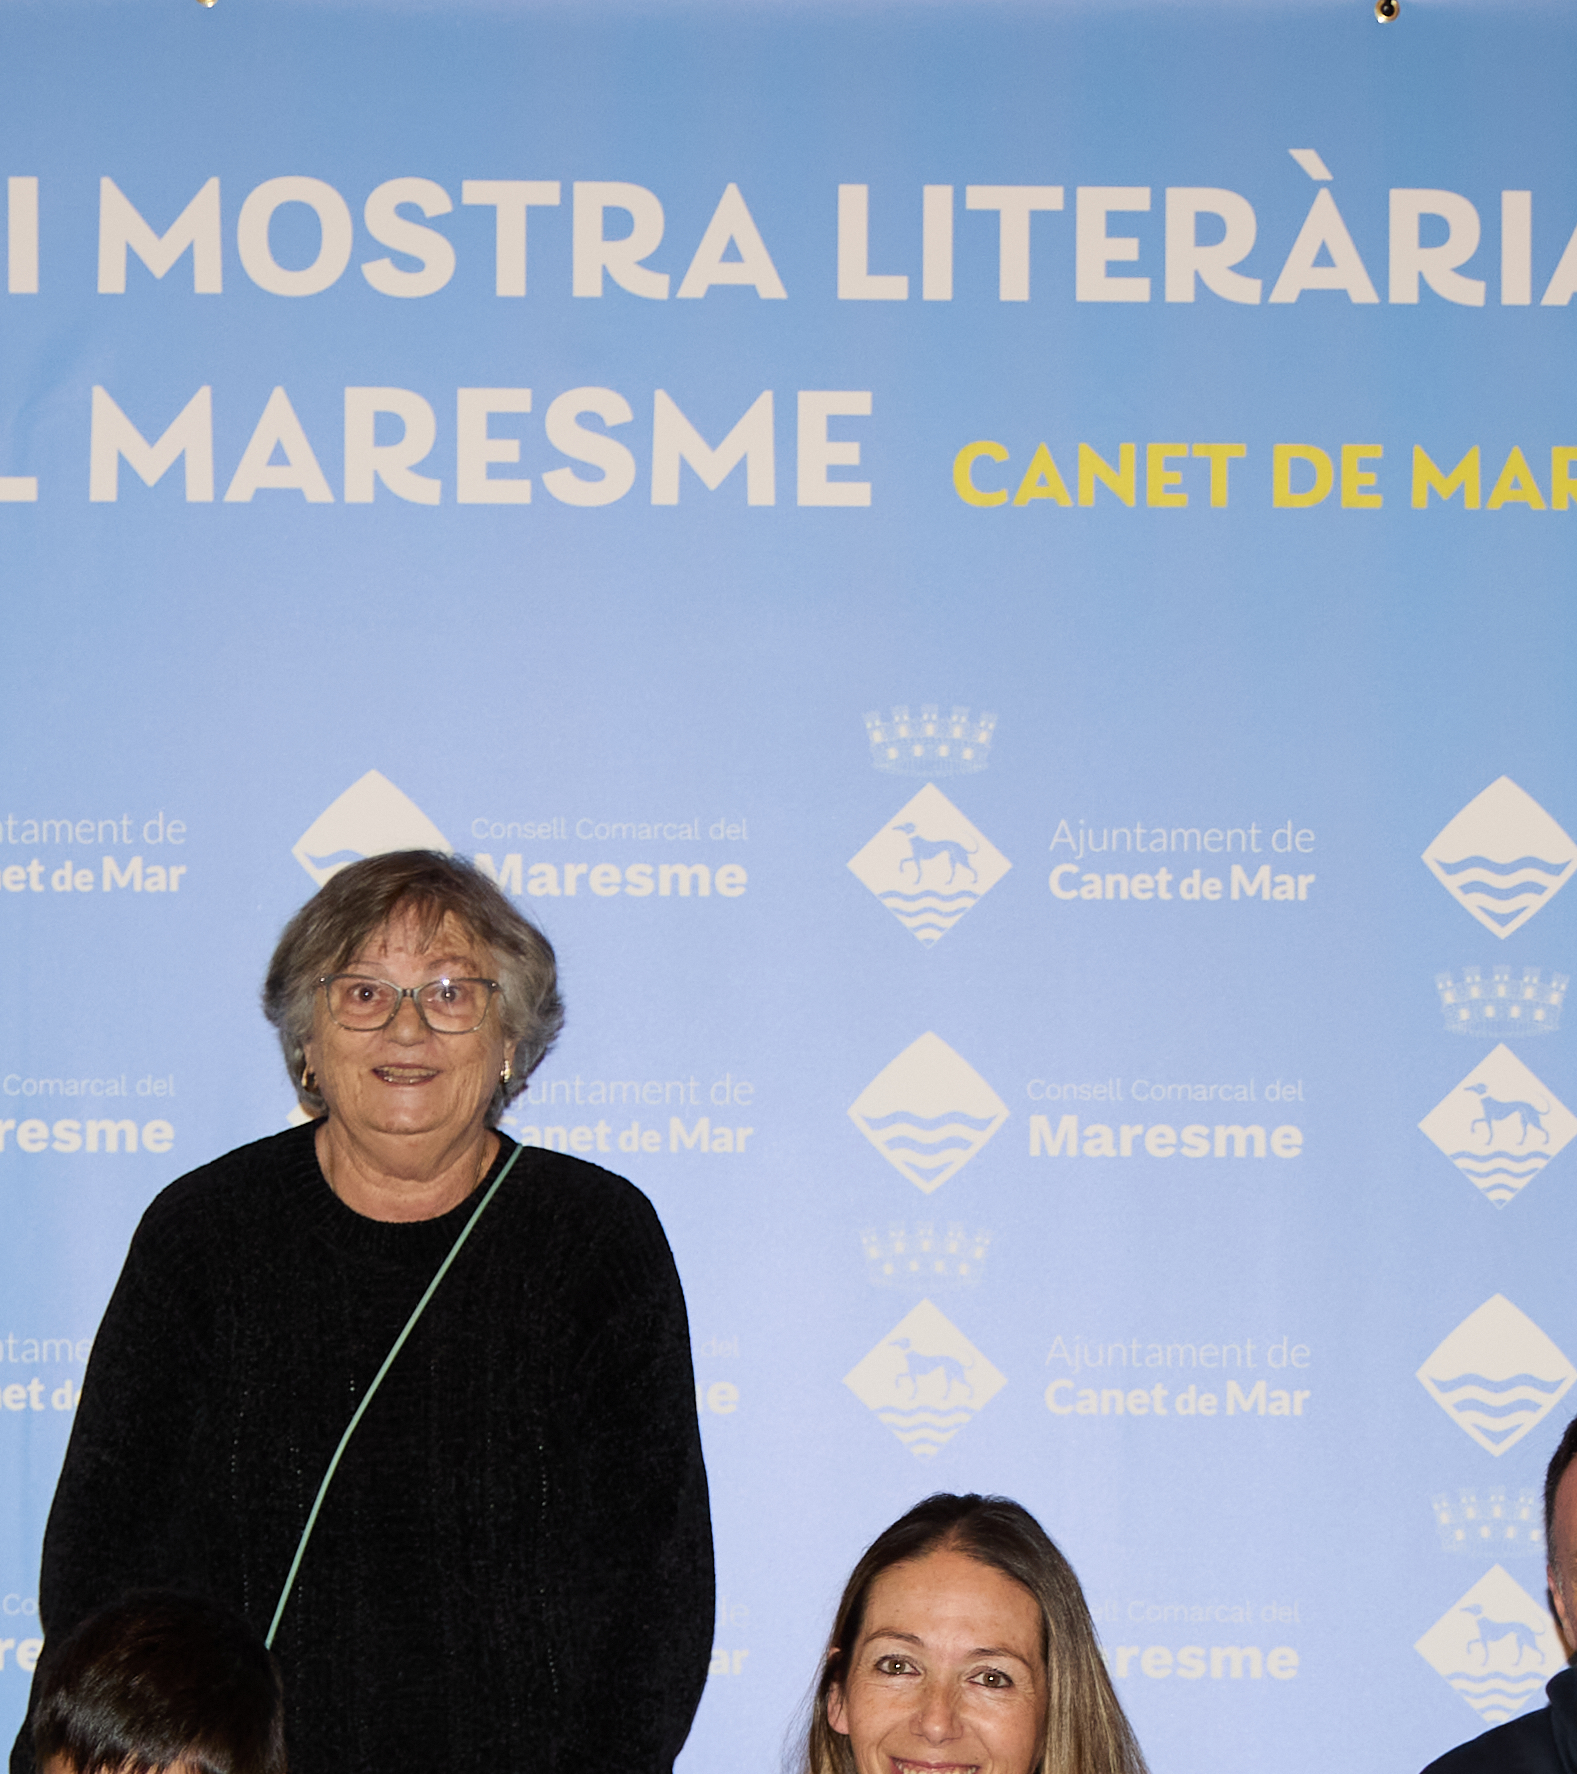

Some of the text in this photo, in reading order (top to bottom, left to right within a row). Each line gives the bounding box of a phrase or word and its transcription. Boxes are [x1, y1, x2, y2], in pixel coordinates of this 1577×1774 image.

[97, 175, 788, 301] MOSTRA
[89, 384, 873, 508] MARESME
[952, 440, 1247, 508] CANET
[1272, 443, 1383, 509] DE
[142, 810, 188, 845] de
[470, 816, 749, 842] Consell Comarcal del
[1048, 818, 1316, 861] Ajuntament de
[50, 860, 95, 893] de
[102, 855, 188, 893] Mar
[475, 852, 748, 898] Maresme
[1048, 862, 1316, 901] Canet de Mar
[2, 1072, 129, 1099] Comarcal
[135, 1073, 176, 1098] del
[518, 1072, 756, 1109] juntament de
[1025, 1078, 1305, 1103] Consell Comarcal del
[617, 1116, 754, 1154] de Mar
[1029, 1113, 1304, 1159] Maresme
[1044, 1333, 1311, 1376] Ajuntament de
[1044, 1378, 1311, 1417] Canet de Mar
[1116, 1645, 1299, 1680] resme
